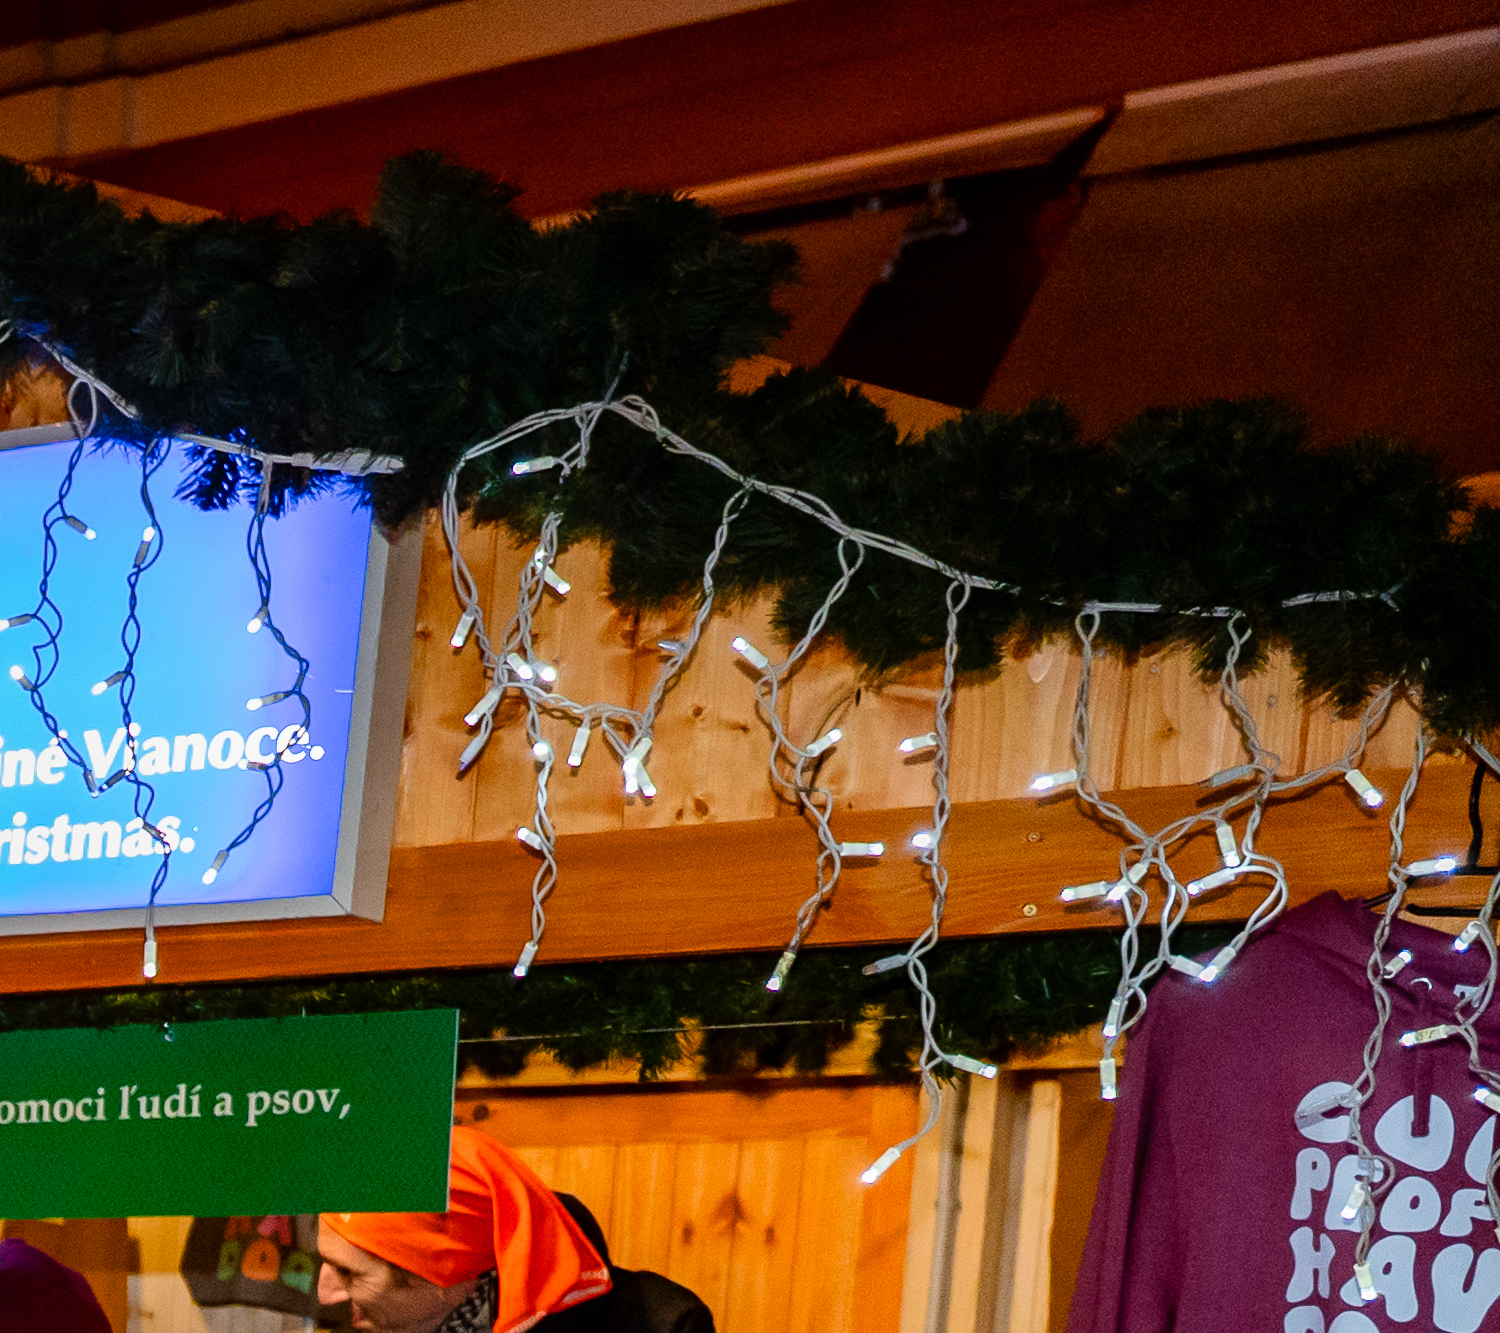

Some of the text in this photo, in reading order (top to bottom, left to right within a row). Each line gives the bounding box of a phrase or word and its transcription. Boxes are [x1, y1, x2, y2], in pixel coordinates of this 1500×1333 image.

[82, 720, 326, 776] Vianoce.
[117, 1083, 202, 1120] ľudí
[212, 1091, 235, 1117] a
[244, 1087, 351, 1128] psov,
